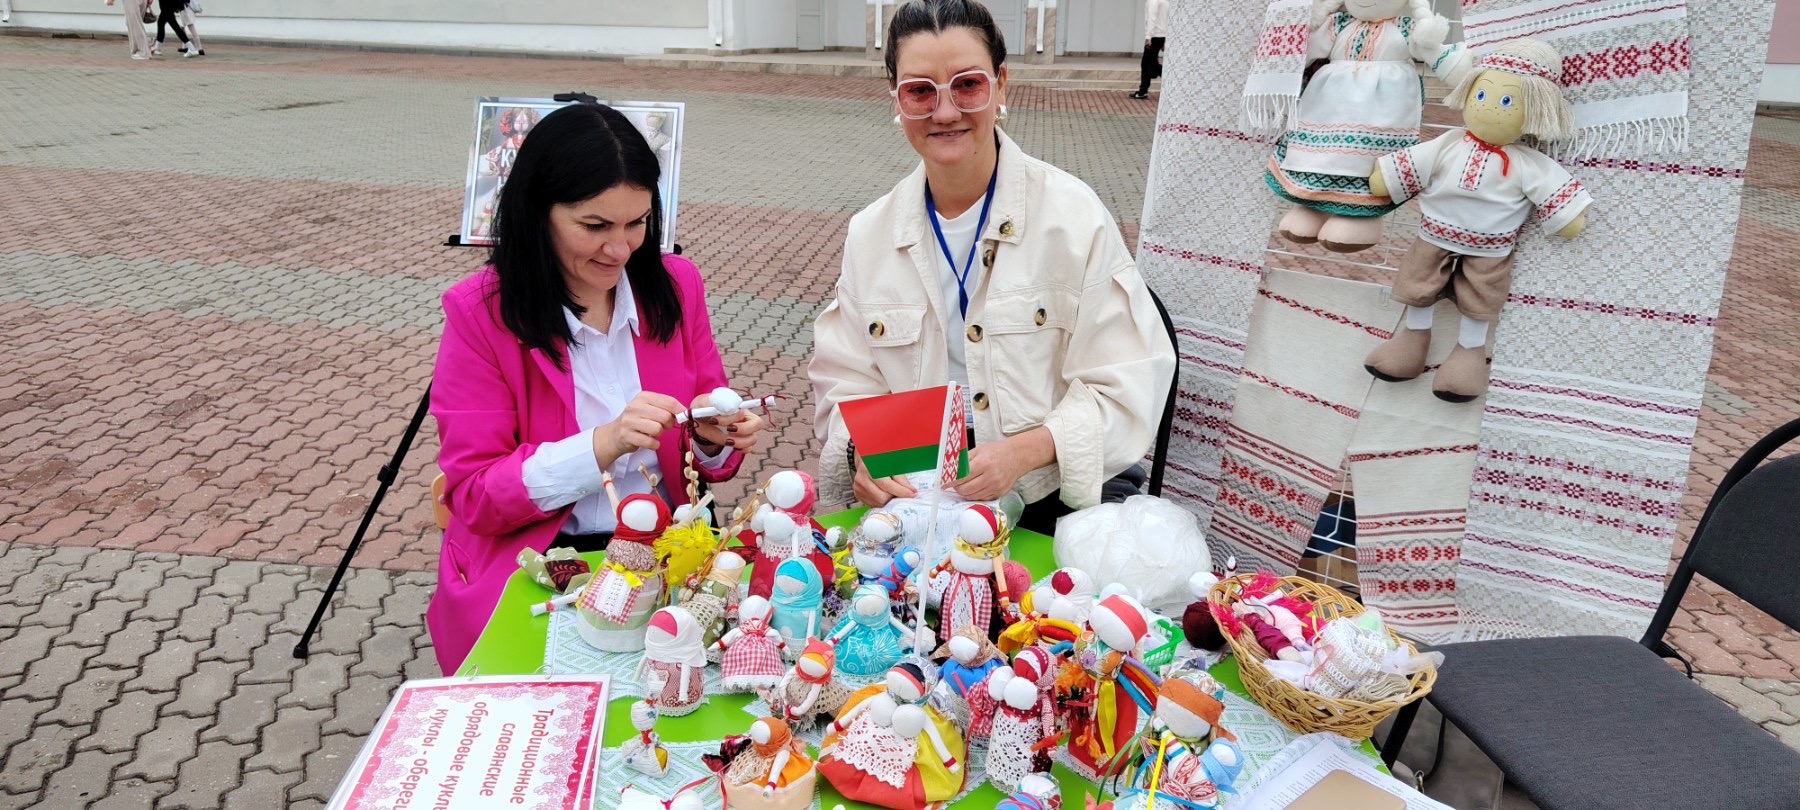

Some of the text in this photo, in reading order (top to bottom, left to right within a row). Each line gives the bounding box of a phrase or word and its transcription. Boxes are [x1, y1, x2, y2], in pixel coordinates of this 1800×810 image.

[421, 708, 449, 747] куклы
[450, 701, 489, 772] обрядовые
[480, 722, 516, 797] славянские
[510, 708, 554, 805] Традиционные
